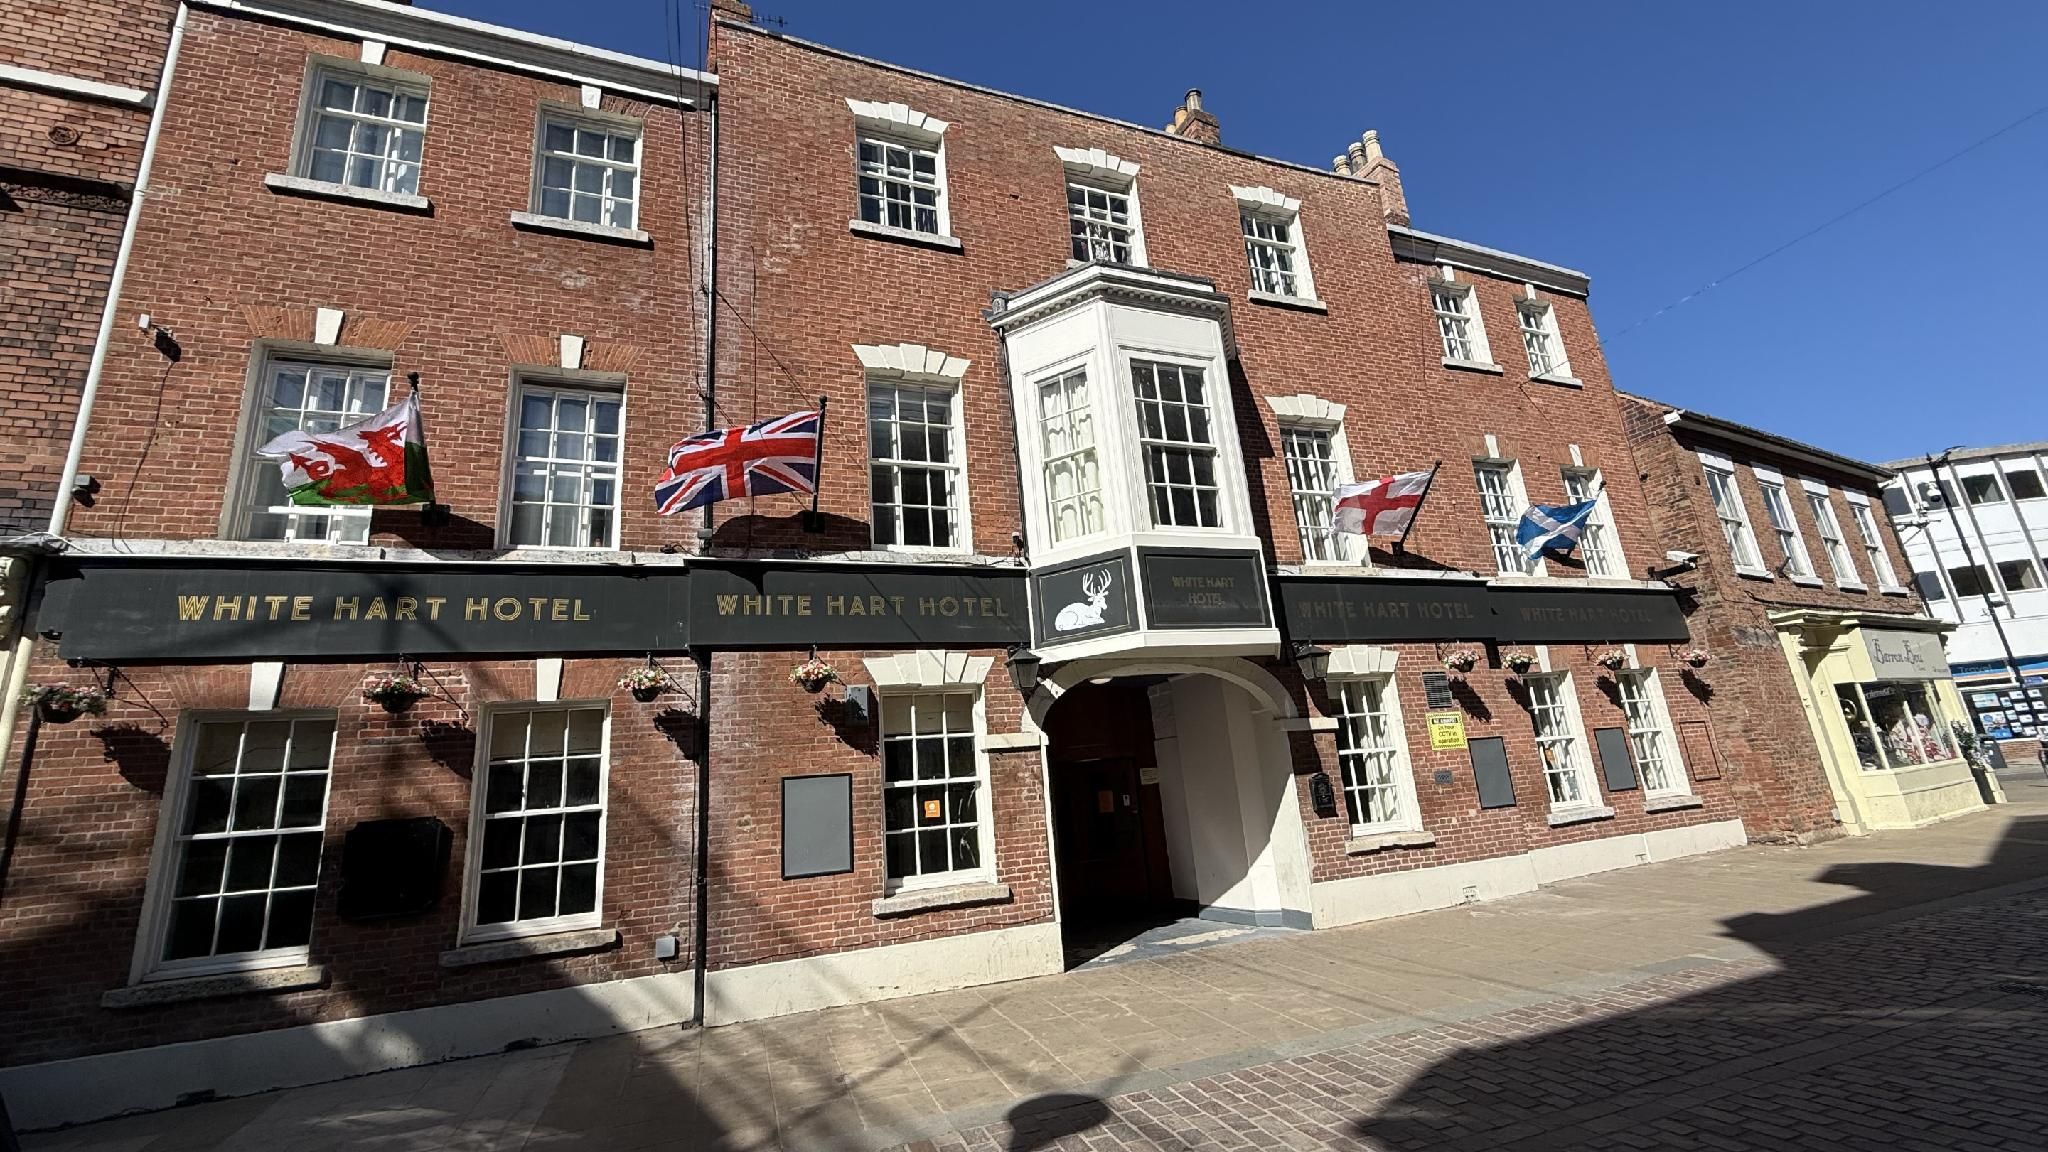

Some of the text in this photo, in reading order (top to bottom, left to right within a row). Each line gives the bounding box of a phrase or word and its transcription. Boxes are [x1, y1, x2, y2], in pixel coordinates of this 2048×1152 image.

[1171, 576, 1235, 588] WHITE HART
[716, 594, 1010, 618] WHITE HART HOTEL
[1188, 592, 1226, 605] HOTEL
[177, 595, 592, 622] WHITE HART HOTEL
[1298, 601, 1476, 620] WHITE HART HOTEL
[1519, 607, 1653, 622] WHITE HART HOTEL
[1958, 664, 1993, 674] Travel
